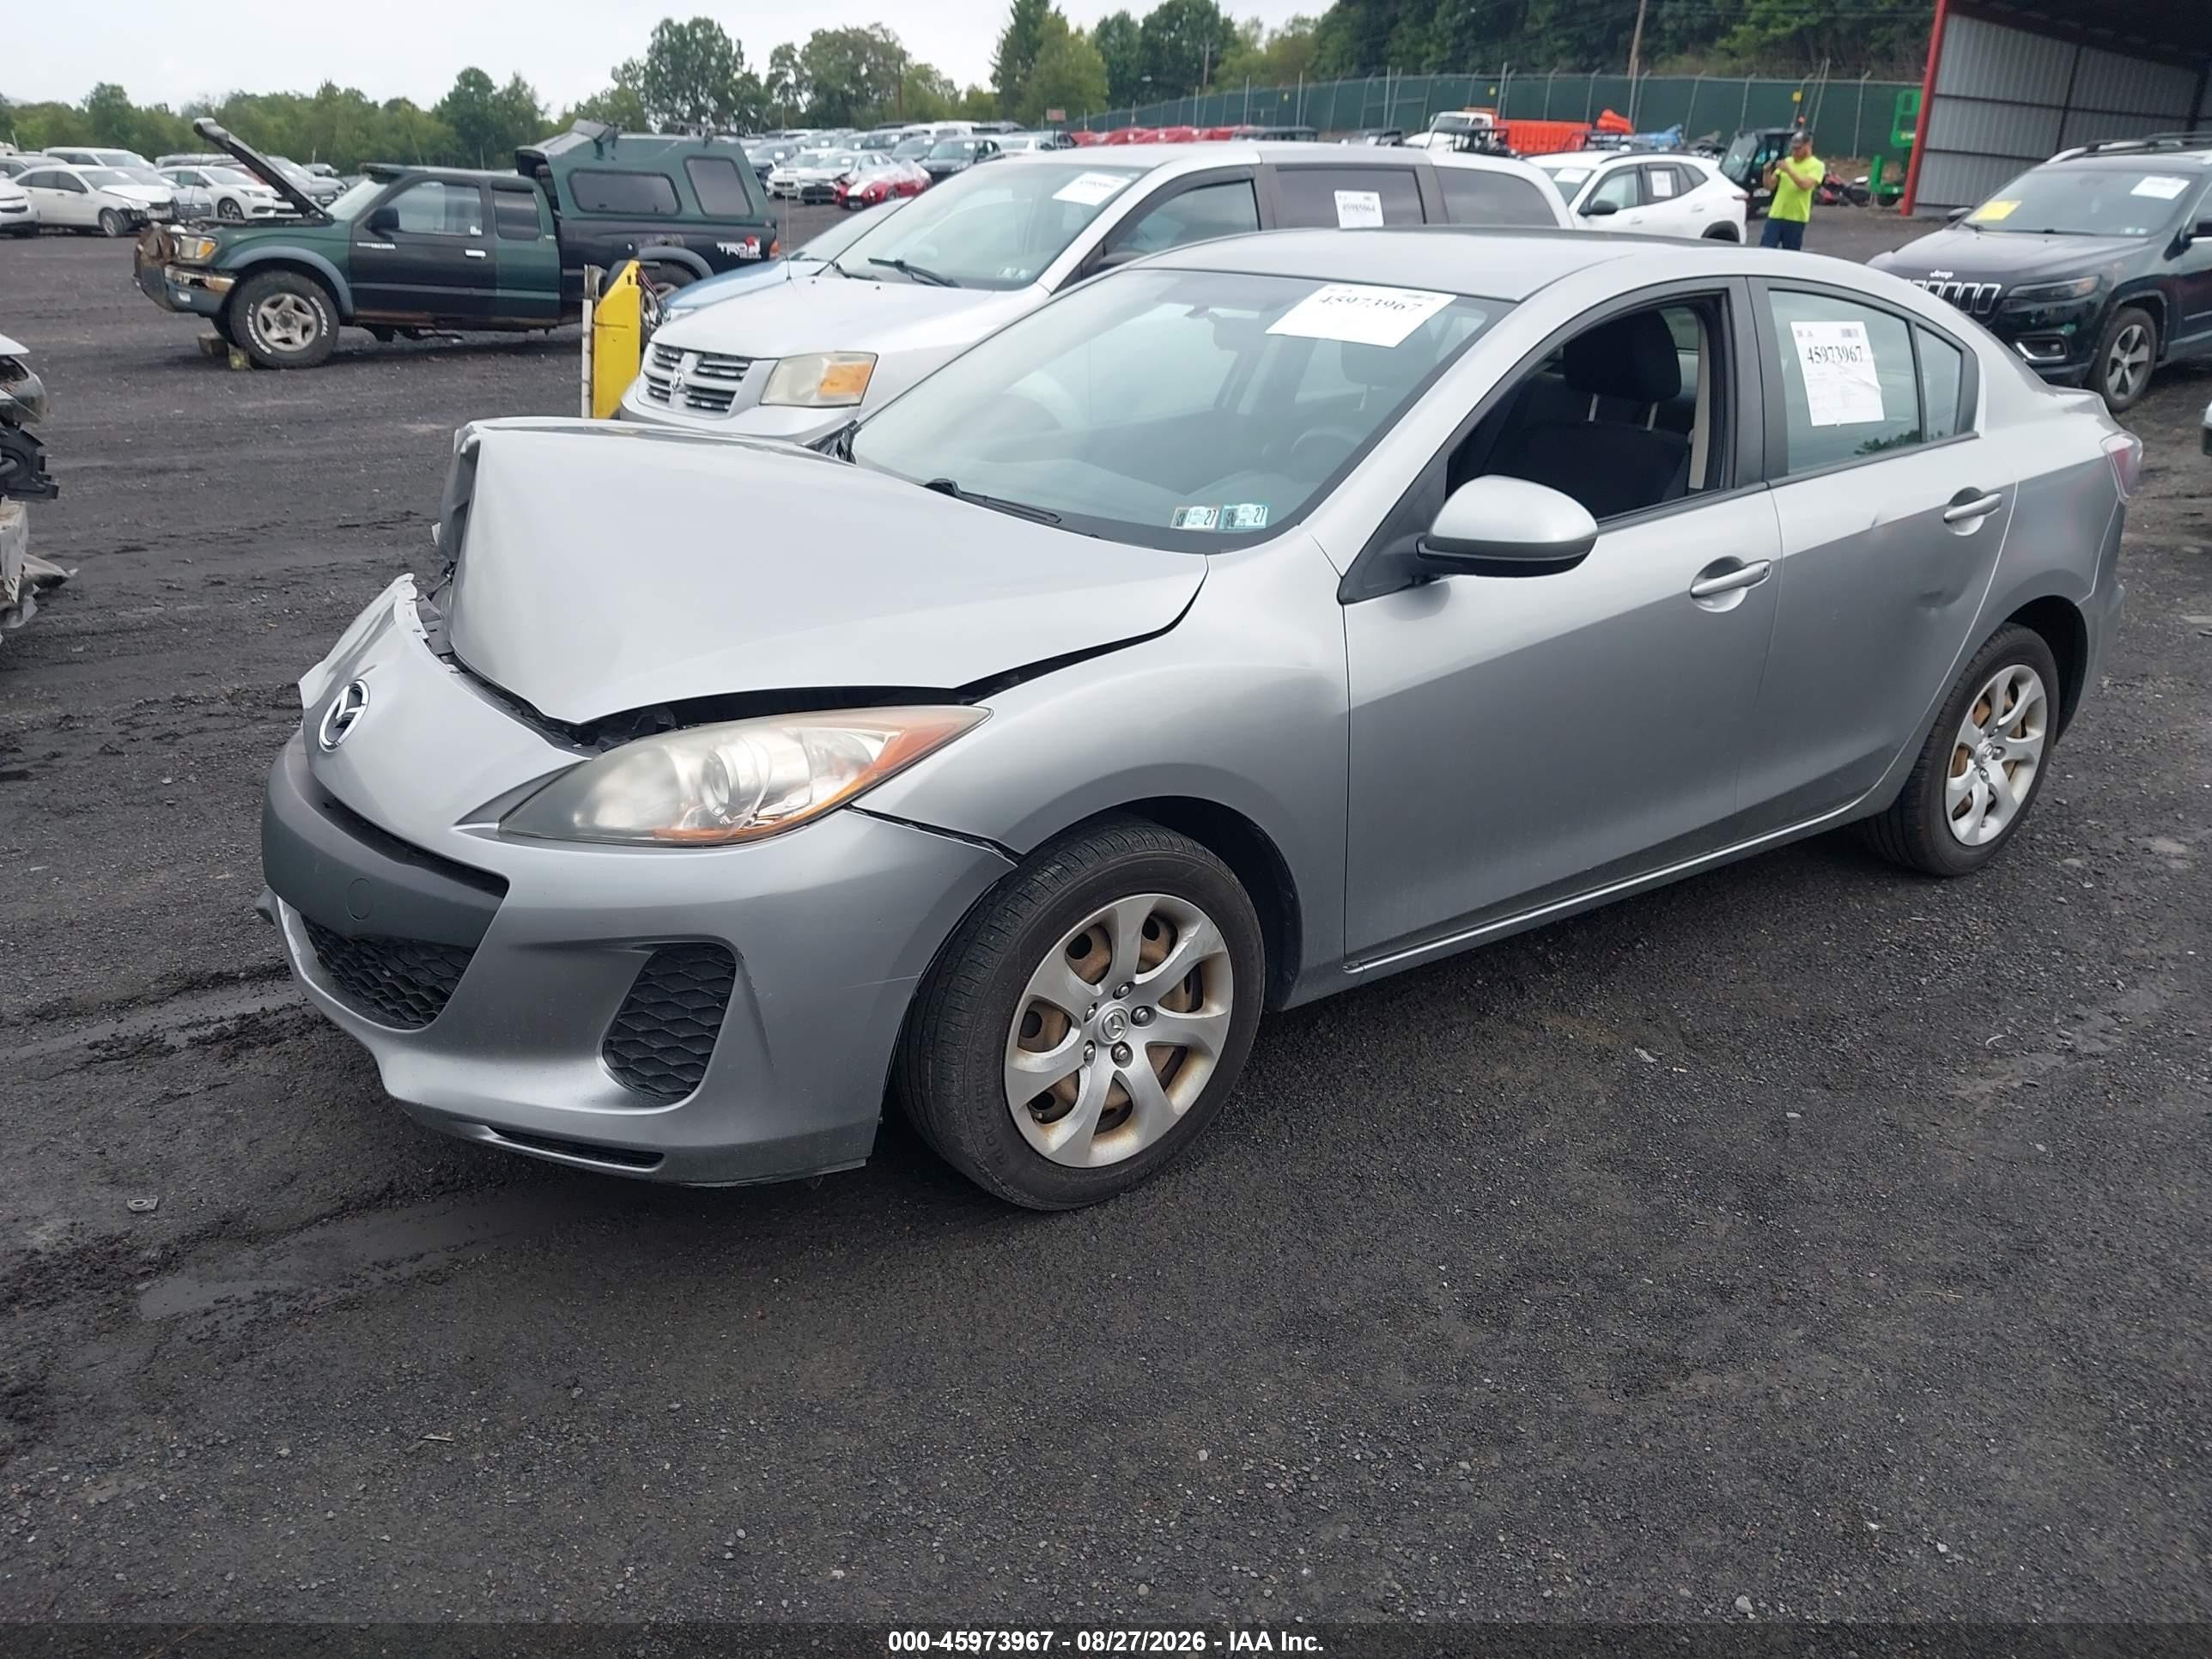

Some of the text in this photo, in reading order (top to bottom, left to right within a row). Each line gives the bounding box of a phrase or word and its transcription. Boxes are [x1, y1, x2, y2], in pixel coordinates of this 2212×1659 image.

[1808, 345, 1863, 364] 45973967
[1204, 509, 1217, 526] 27
[1254, 507, 1266, 524] 27
